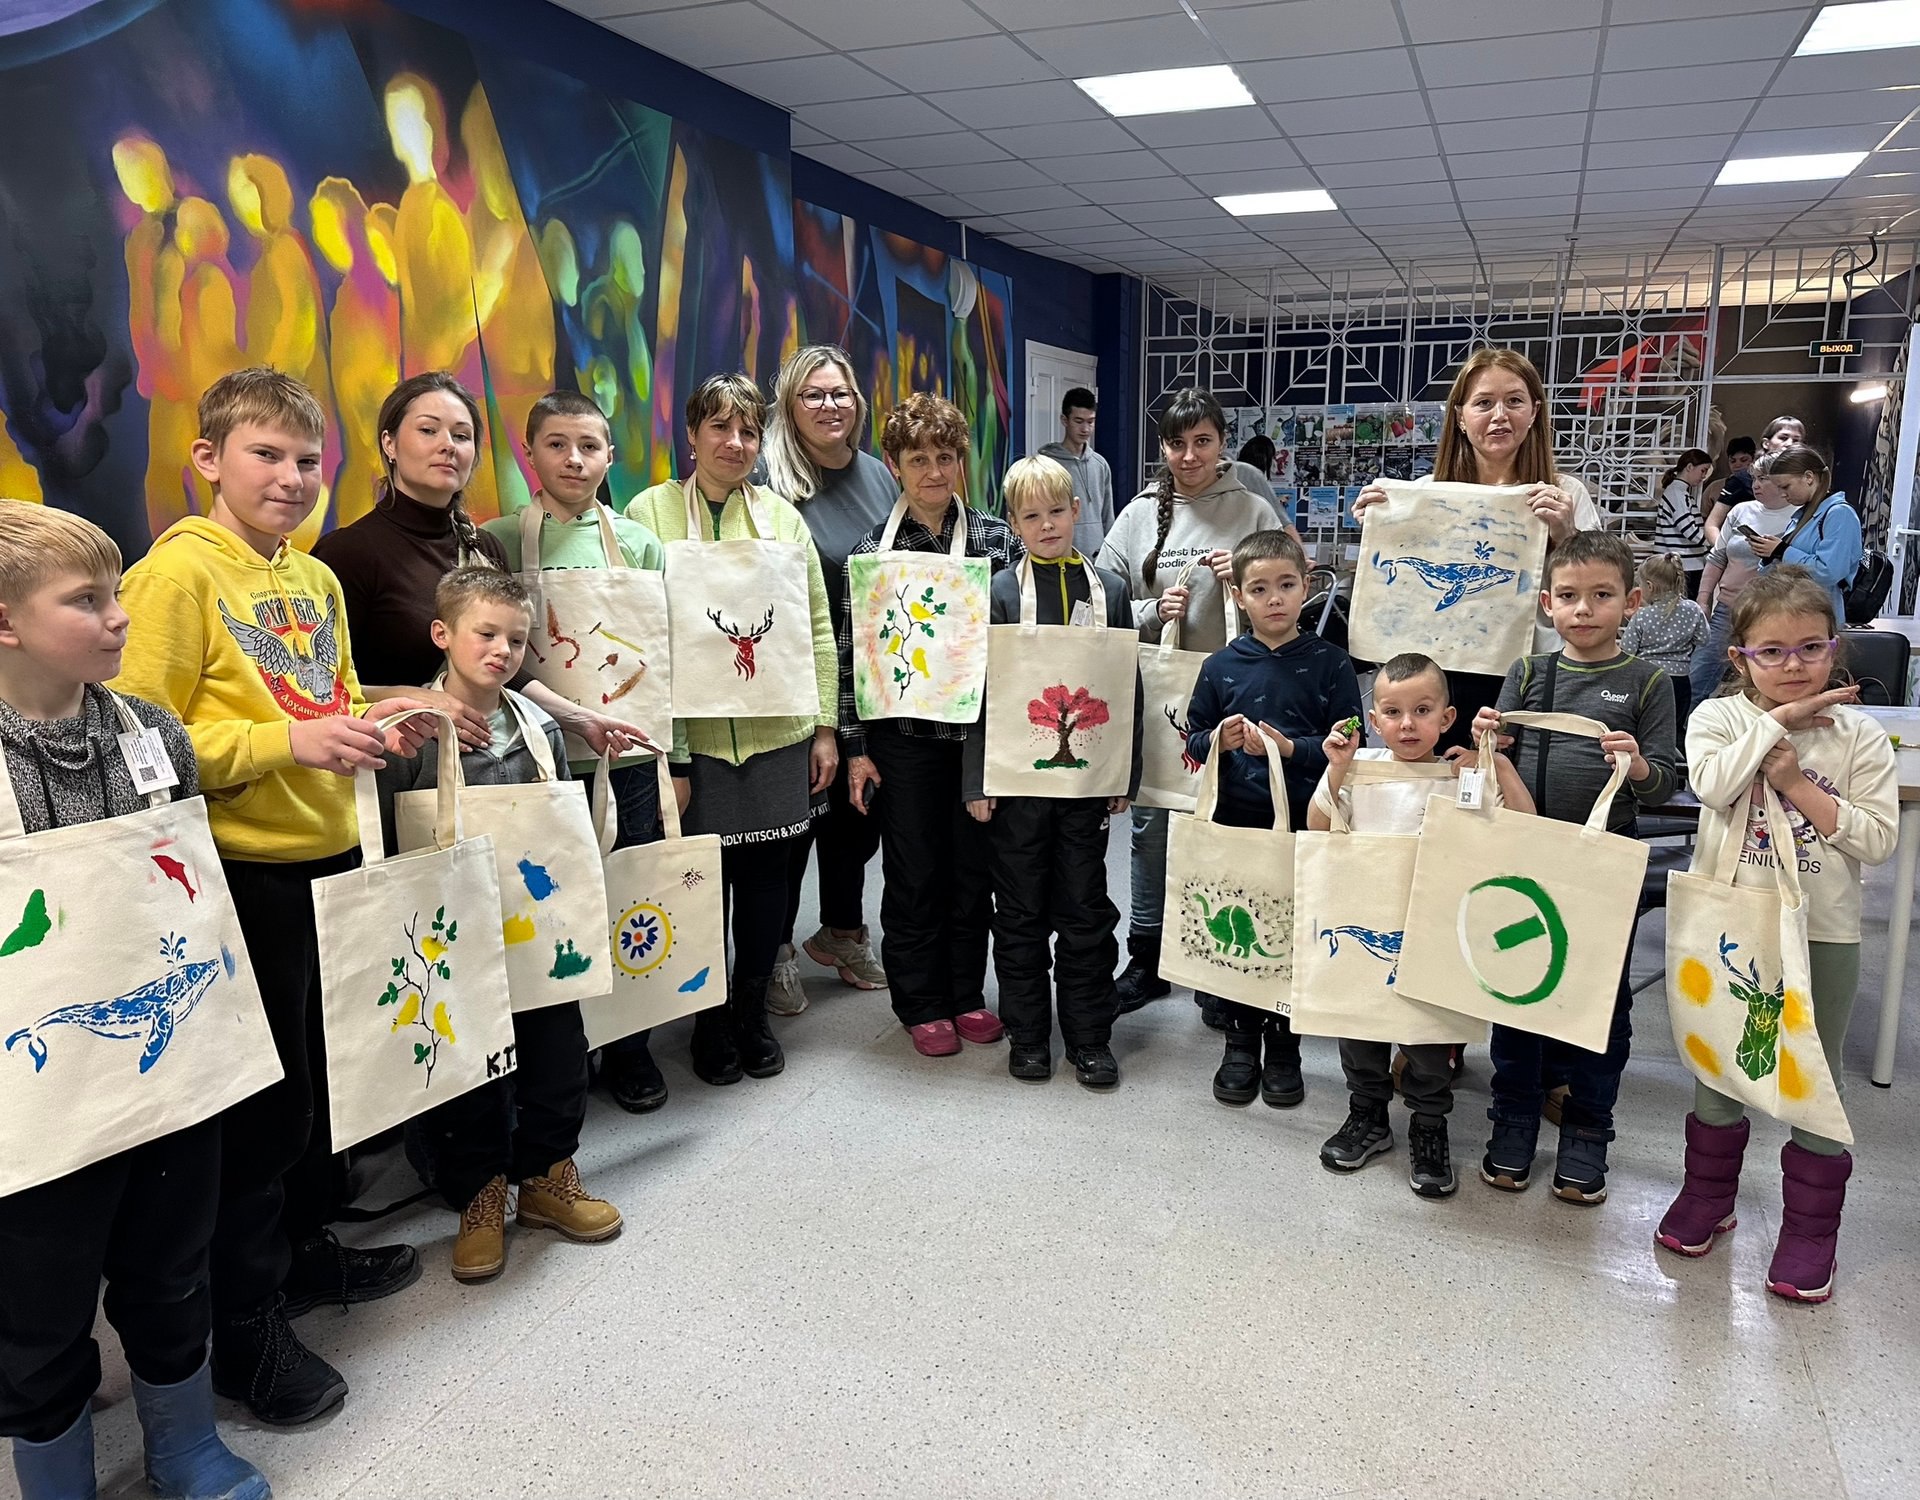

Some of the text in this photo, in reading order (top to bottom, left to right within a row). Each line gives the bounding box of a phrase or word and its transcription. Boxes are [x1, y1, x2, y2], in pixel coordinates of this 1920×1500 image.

[1820, 344, 1854, 353] ВЫХОД
[744, 827, 780, 843] KITSCH
[780, 826, 789, 838] &
